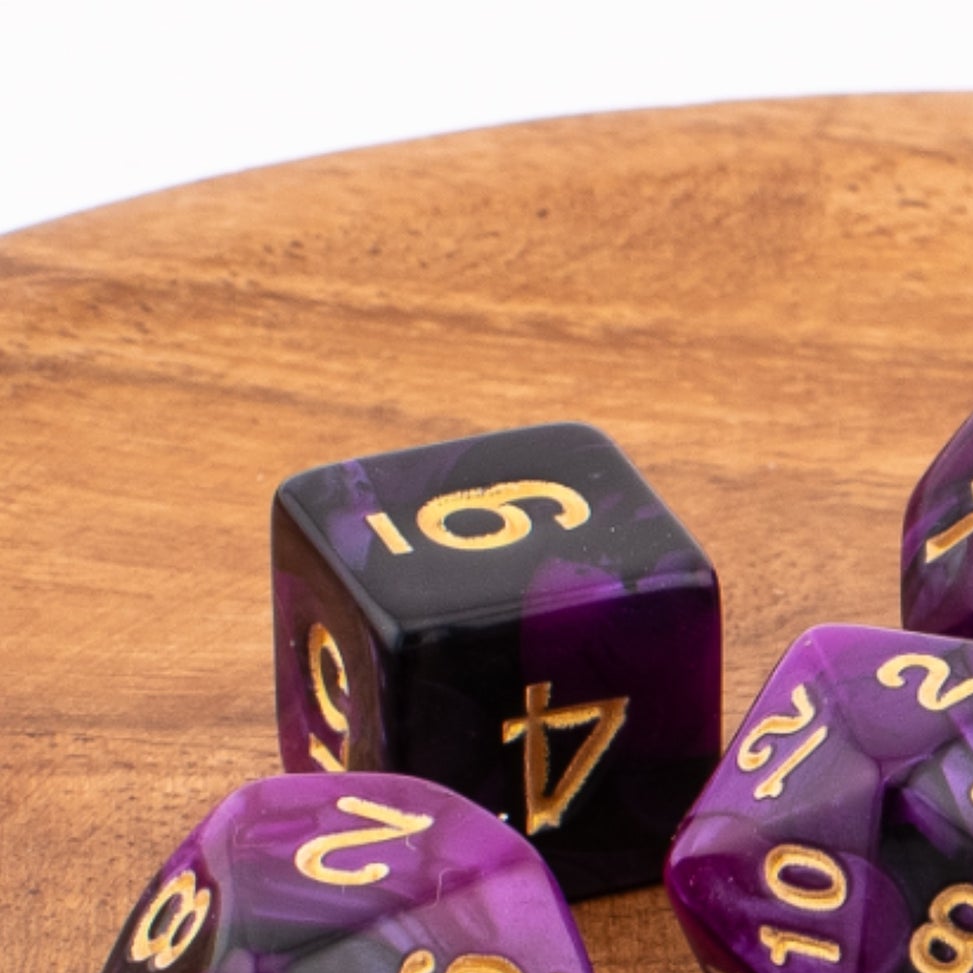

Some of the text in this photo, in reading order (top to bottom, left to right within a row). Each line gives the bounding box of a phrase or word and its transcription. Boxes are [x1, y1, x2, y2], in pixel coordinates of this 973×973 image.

[366, 479, 591, 554] 6
[501, 680, 629, 836] 4
[737, 684, 828, 799] 12
[295, 796, 434, 886] 2
[129, 868, 211, 970] 8
[758, 843, 848, 967] 10
